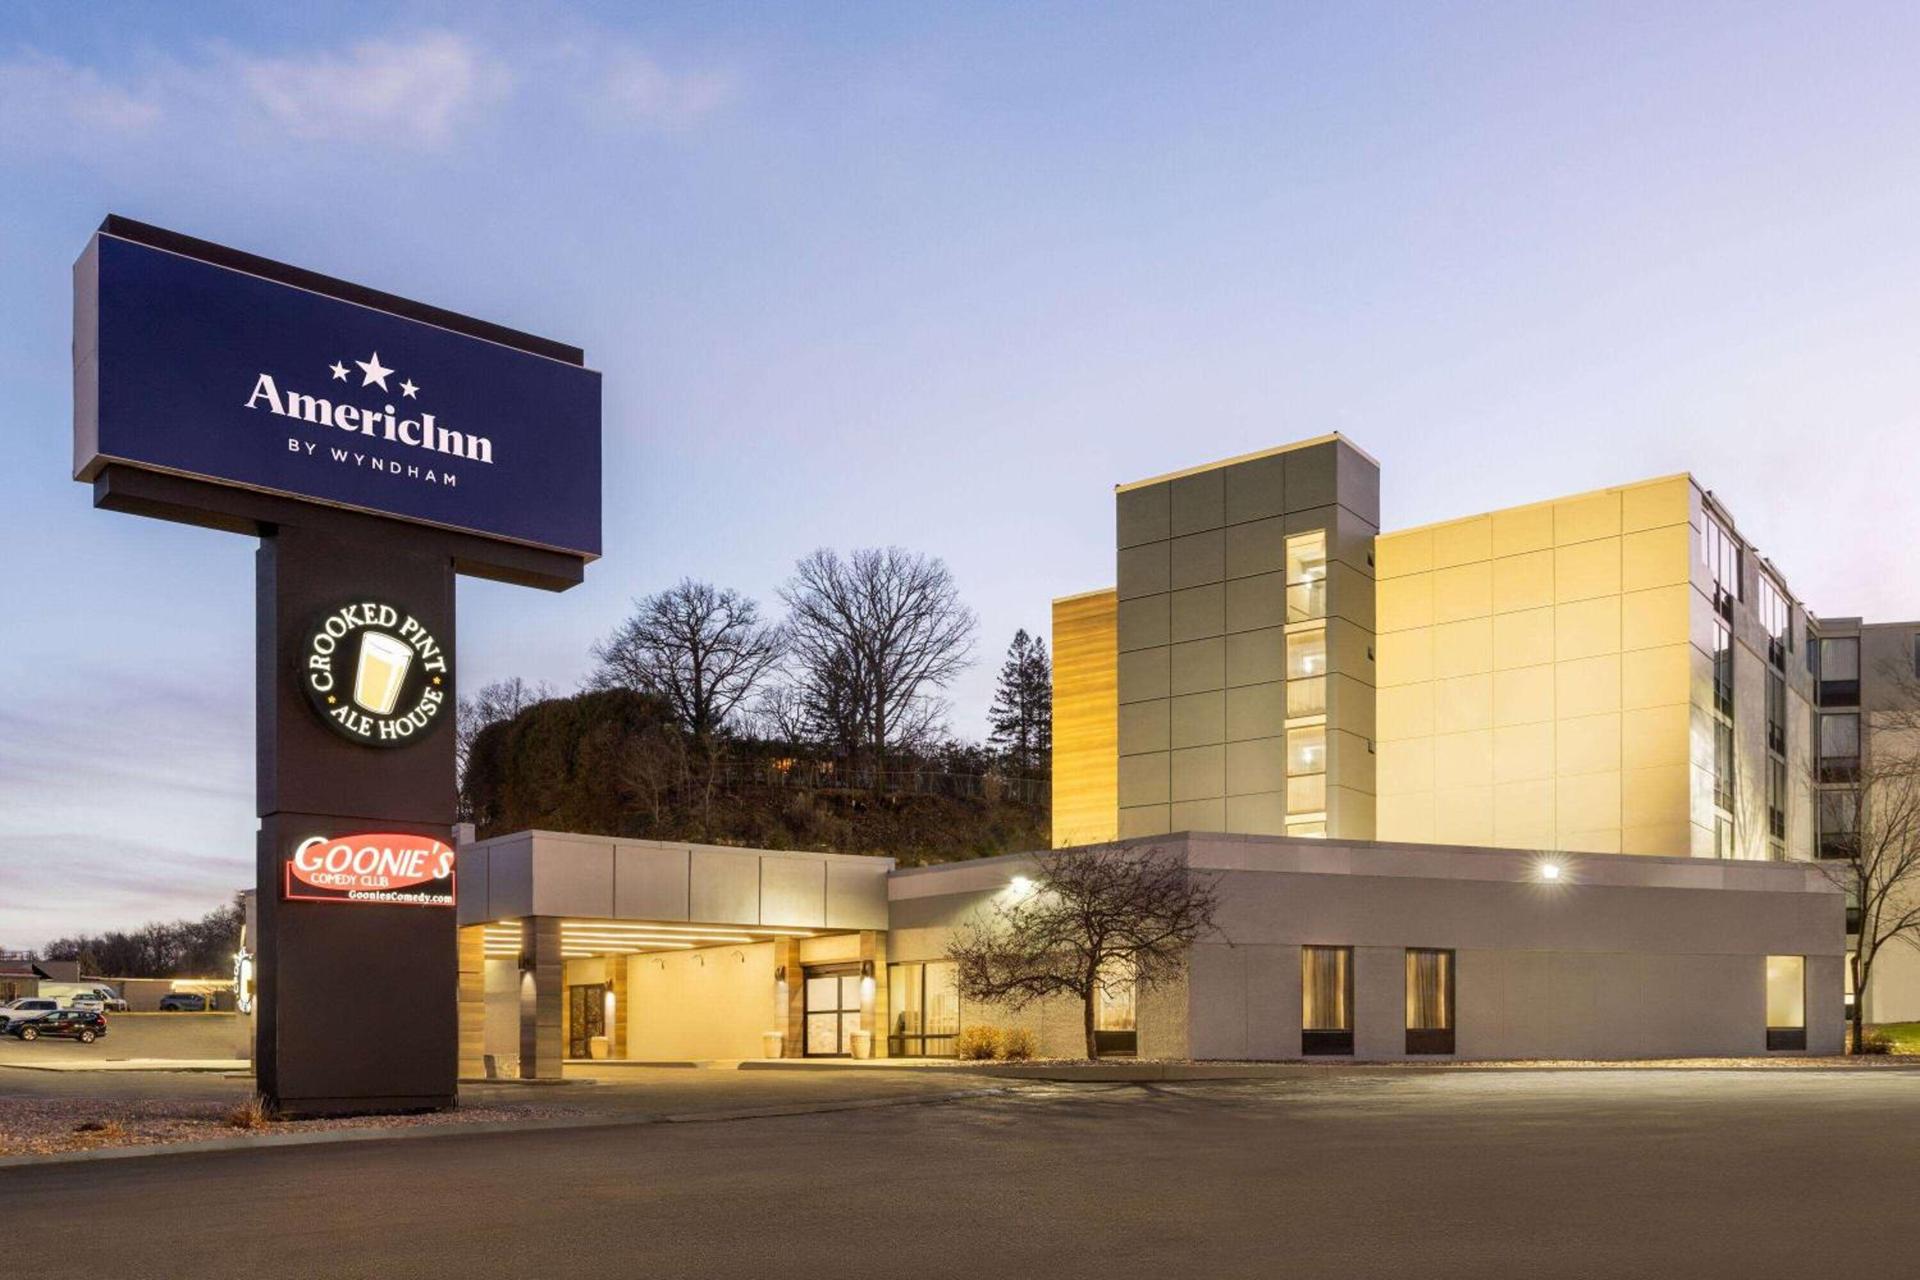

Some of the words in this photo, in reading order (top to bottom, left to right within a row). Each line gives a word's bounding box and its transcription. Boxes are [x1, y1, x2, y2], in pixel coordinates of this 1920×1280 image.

[244, 373, 494, 464] AmericInn
[288, 438, 316, 455] BY
[331, 448, 457, 487] WYNDHAM
[309, 603, 397, 692] CROOKED
[399, 615, 447, 673] PINT
[330, 705, 374, 736] ALE
[378, 687, 444, 739] HOUSE
[295, 837, 454, 879] GOONIE'S
[310, 873, 357, 884] COMEDY
[361, 876, 389, 887] CLUB
[348, 890, 453, 904] GooniesComedy.com
